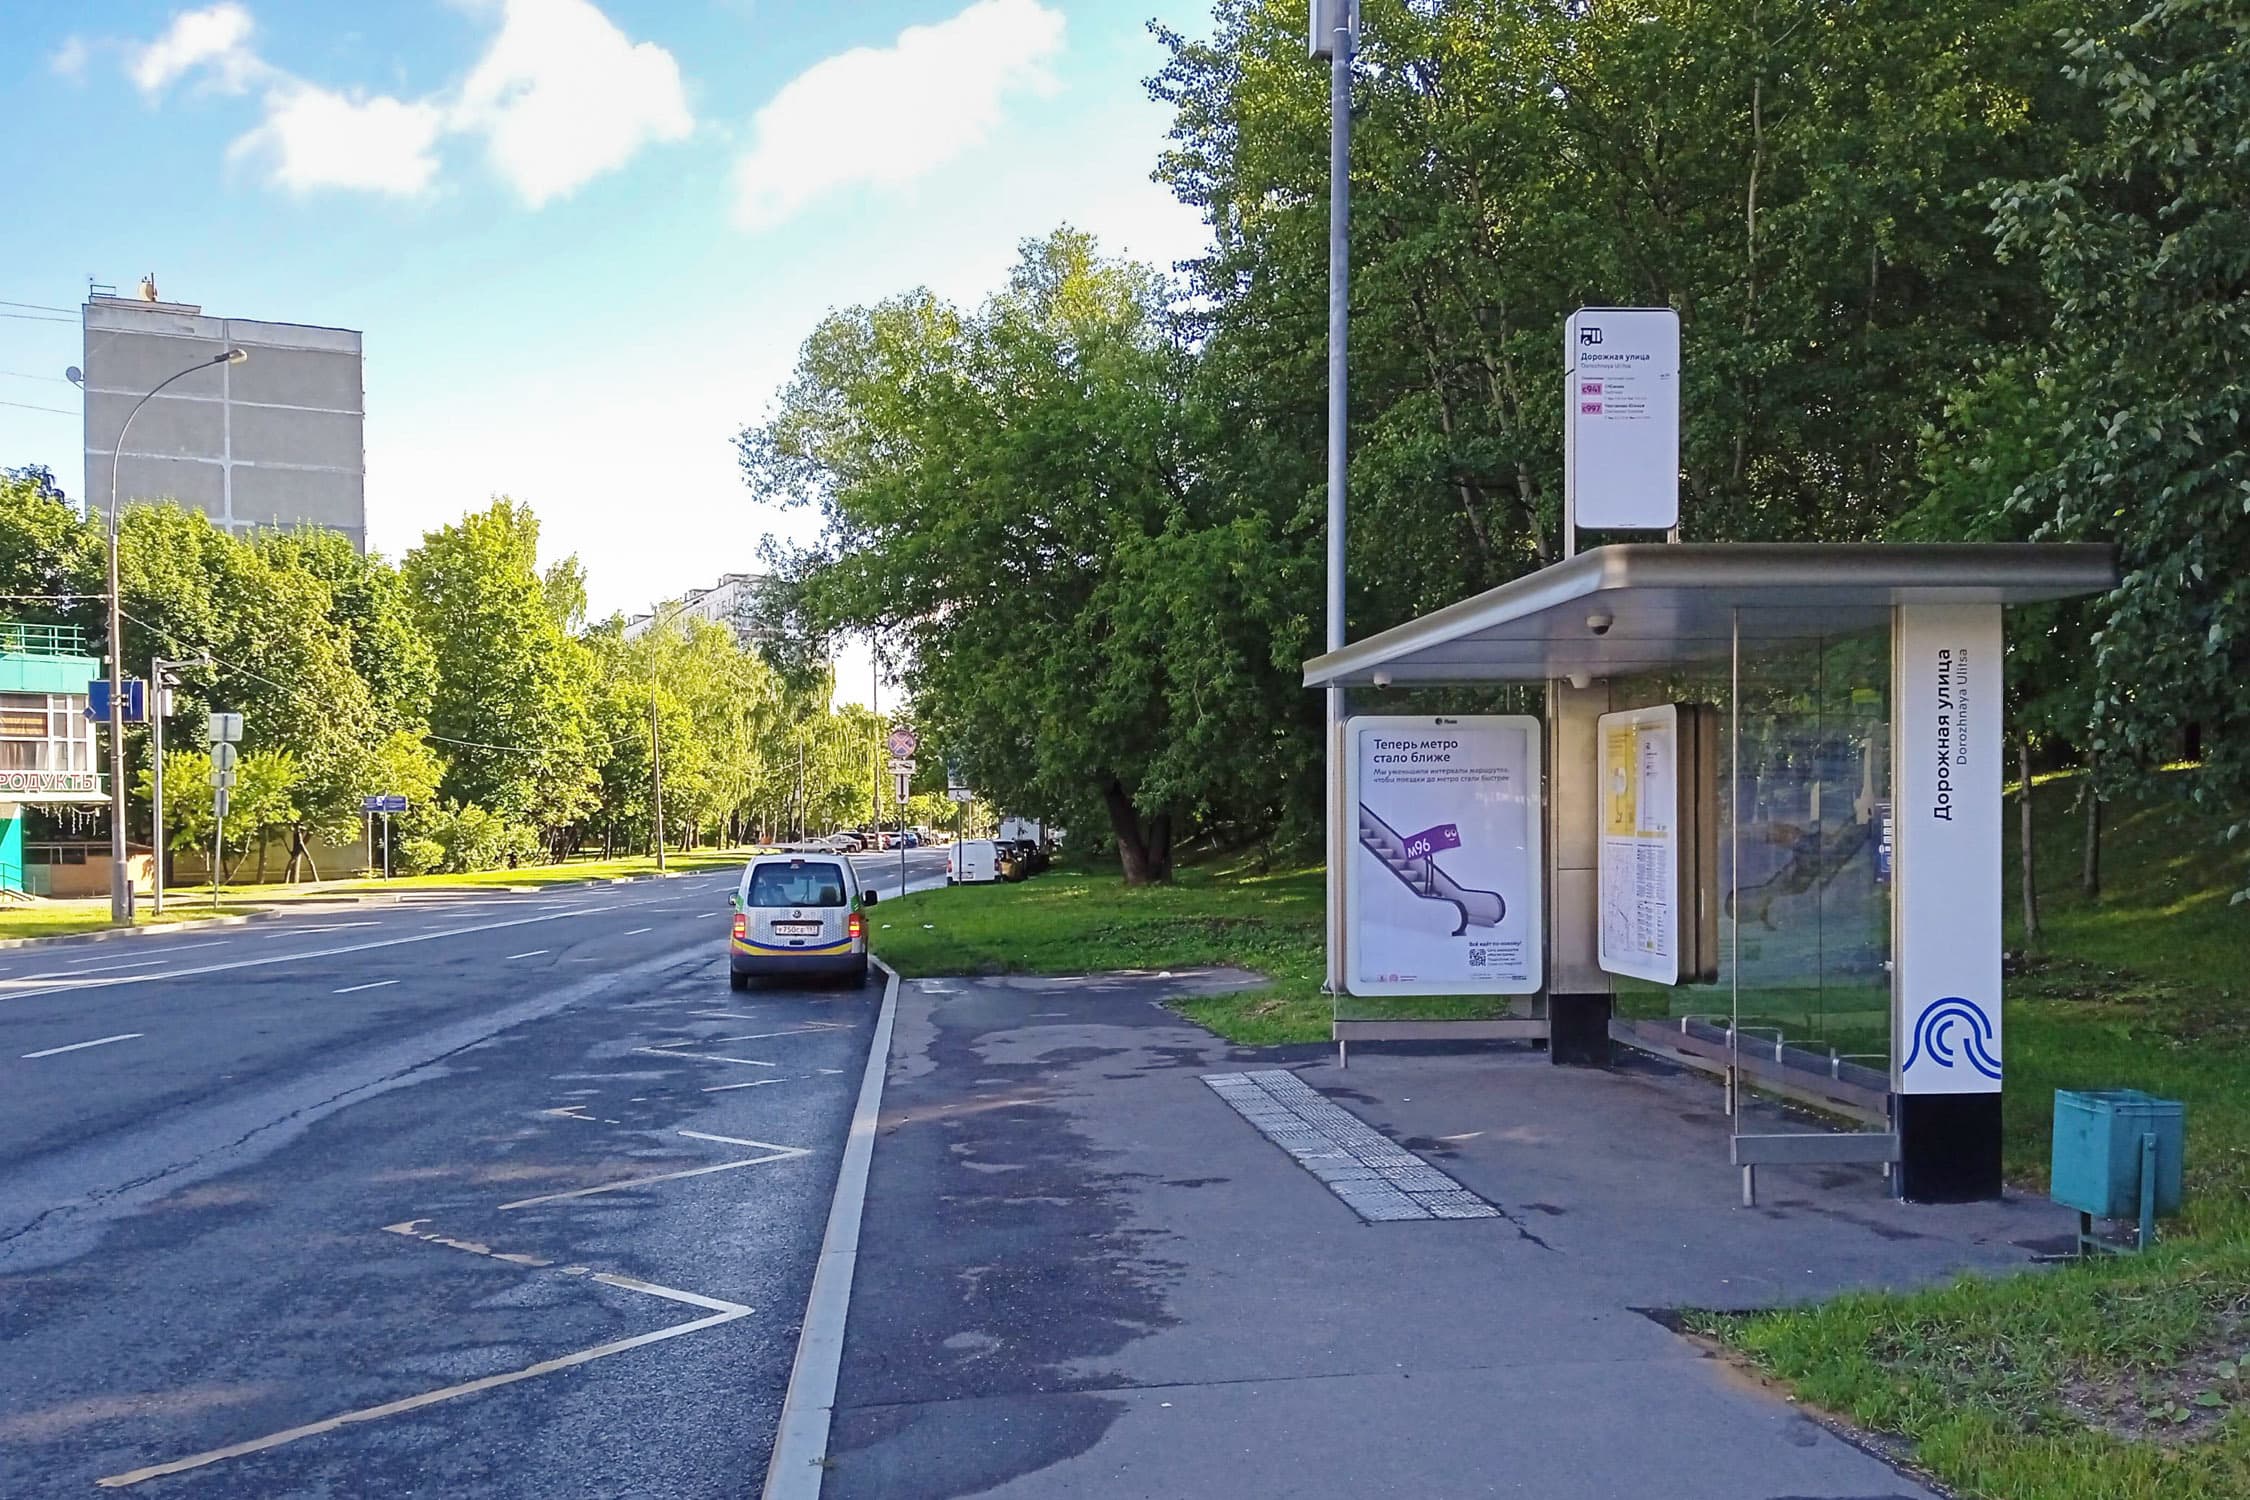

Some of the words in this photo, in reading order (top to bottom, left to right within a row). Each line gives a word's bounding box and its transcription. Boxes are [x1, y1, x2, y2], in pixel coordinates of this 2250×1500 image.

[1581, 352, 1624, 361] Дорожная
[1625, 354, 1650, 362] улица
[1938, 649, 1954, 710] улица
[1956, 648, 1968, 686] Ulitsa
[1373, 739, 1418, 751] Теперь
[1420, 740, 1459, 751] метро
[1956, 688, 1969, 765] Dorozhnaya
[1373, 754, 1408, 763] стало
[1411, 751, 1451, 763] ближе
[1934, 713, 1953, 821] Дорожная
